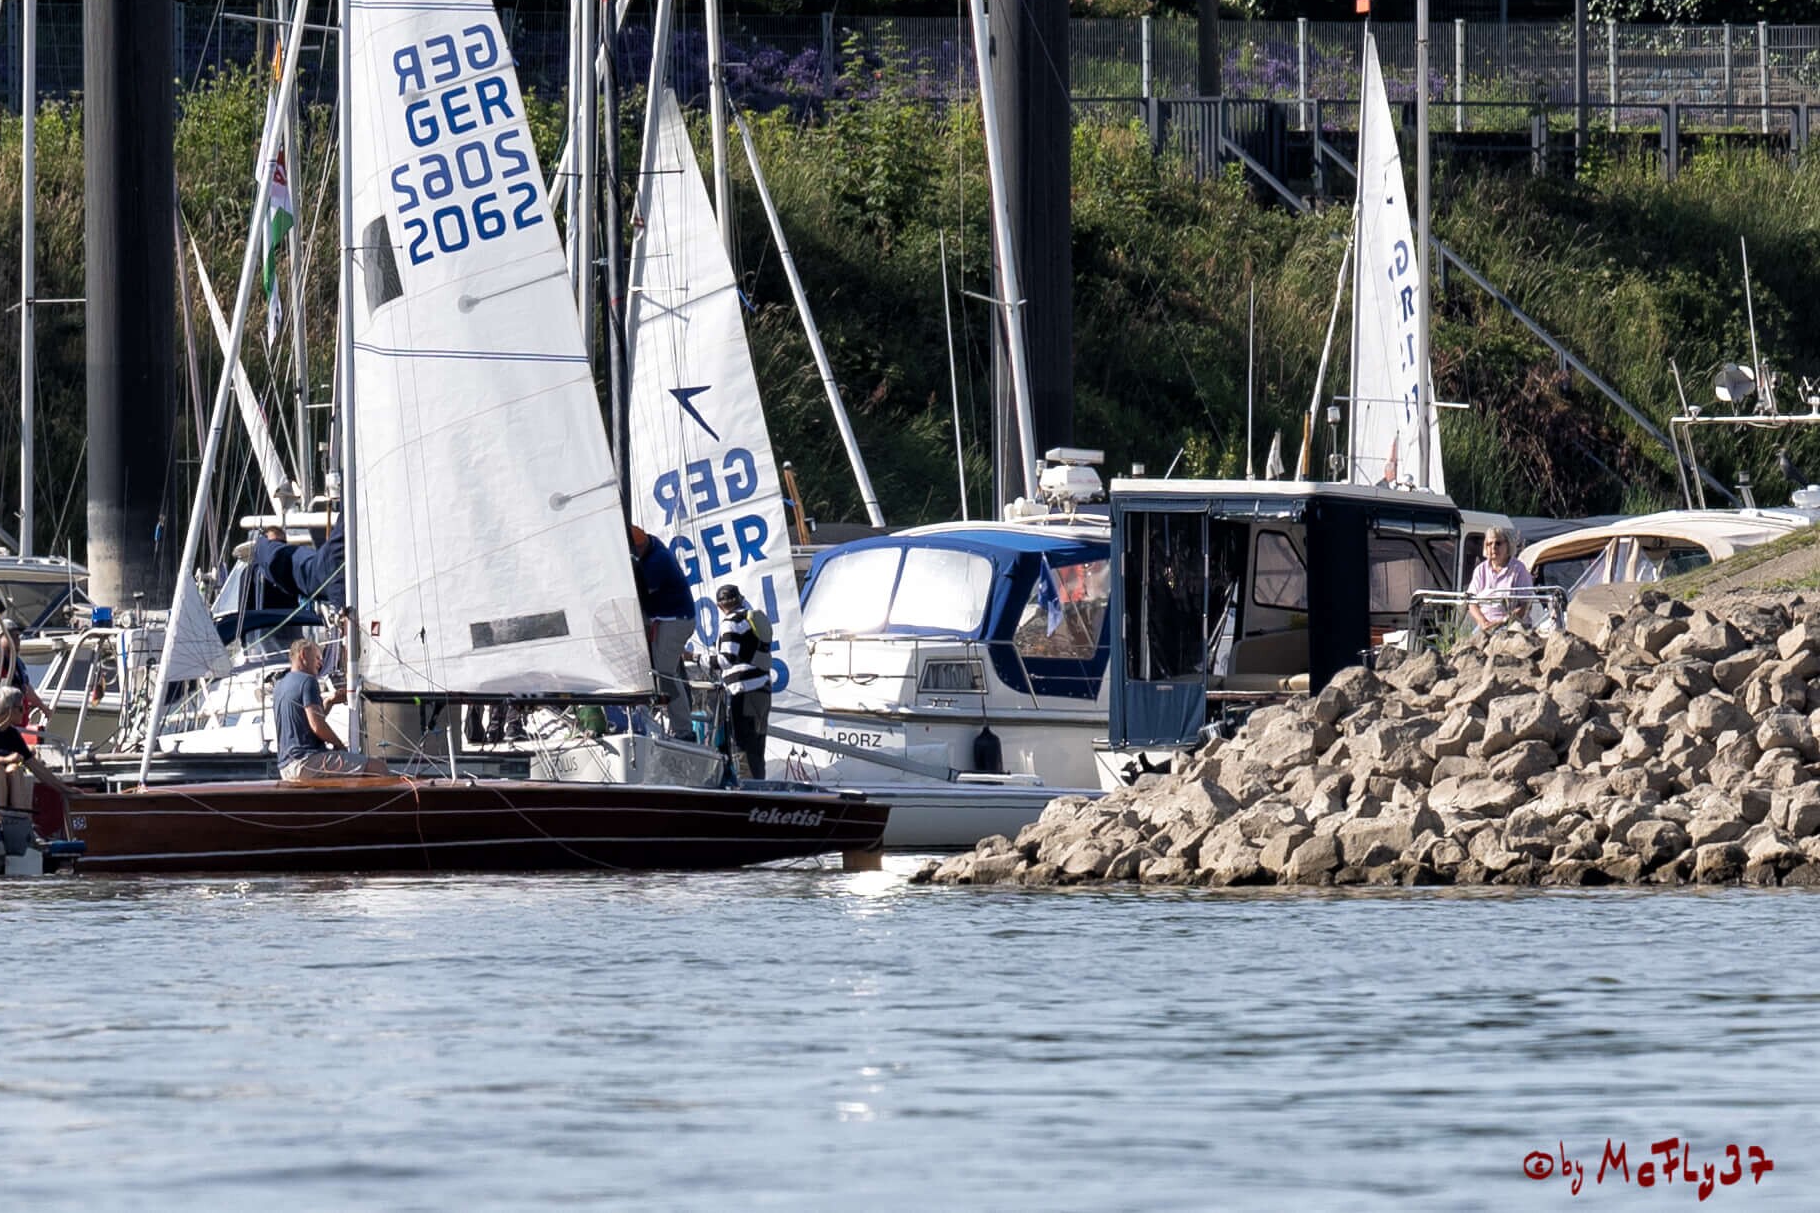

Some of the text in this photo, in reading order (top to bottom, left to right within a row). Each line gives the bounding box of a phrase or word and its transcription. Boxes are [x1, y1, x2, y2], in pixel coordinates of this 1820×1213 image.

[405, 76, 515, 148] GER
[404, 181, 544, 266] 2062
[668, 514, 768, 586] GER
[837, 731, 882, 748] PORZ
[747, 806, 825, 826] teketisi
